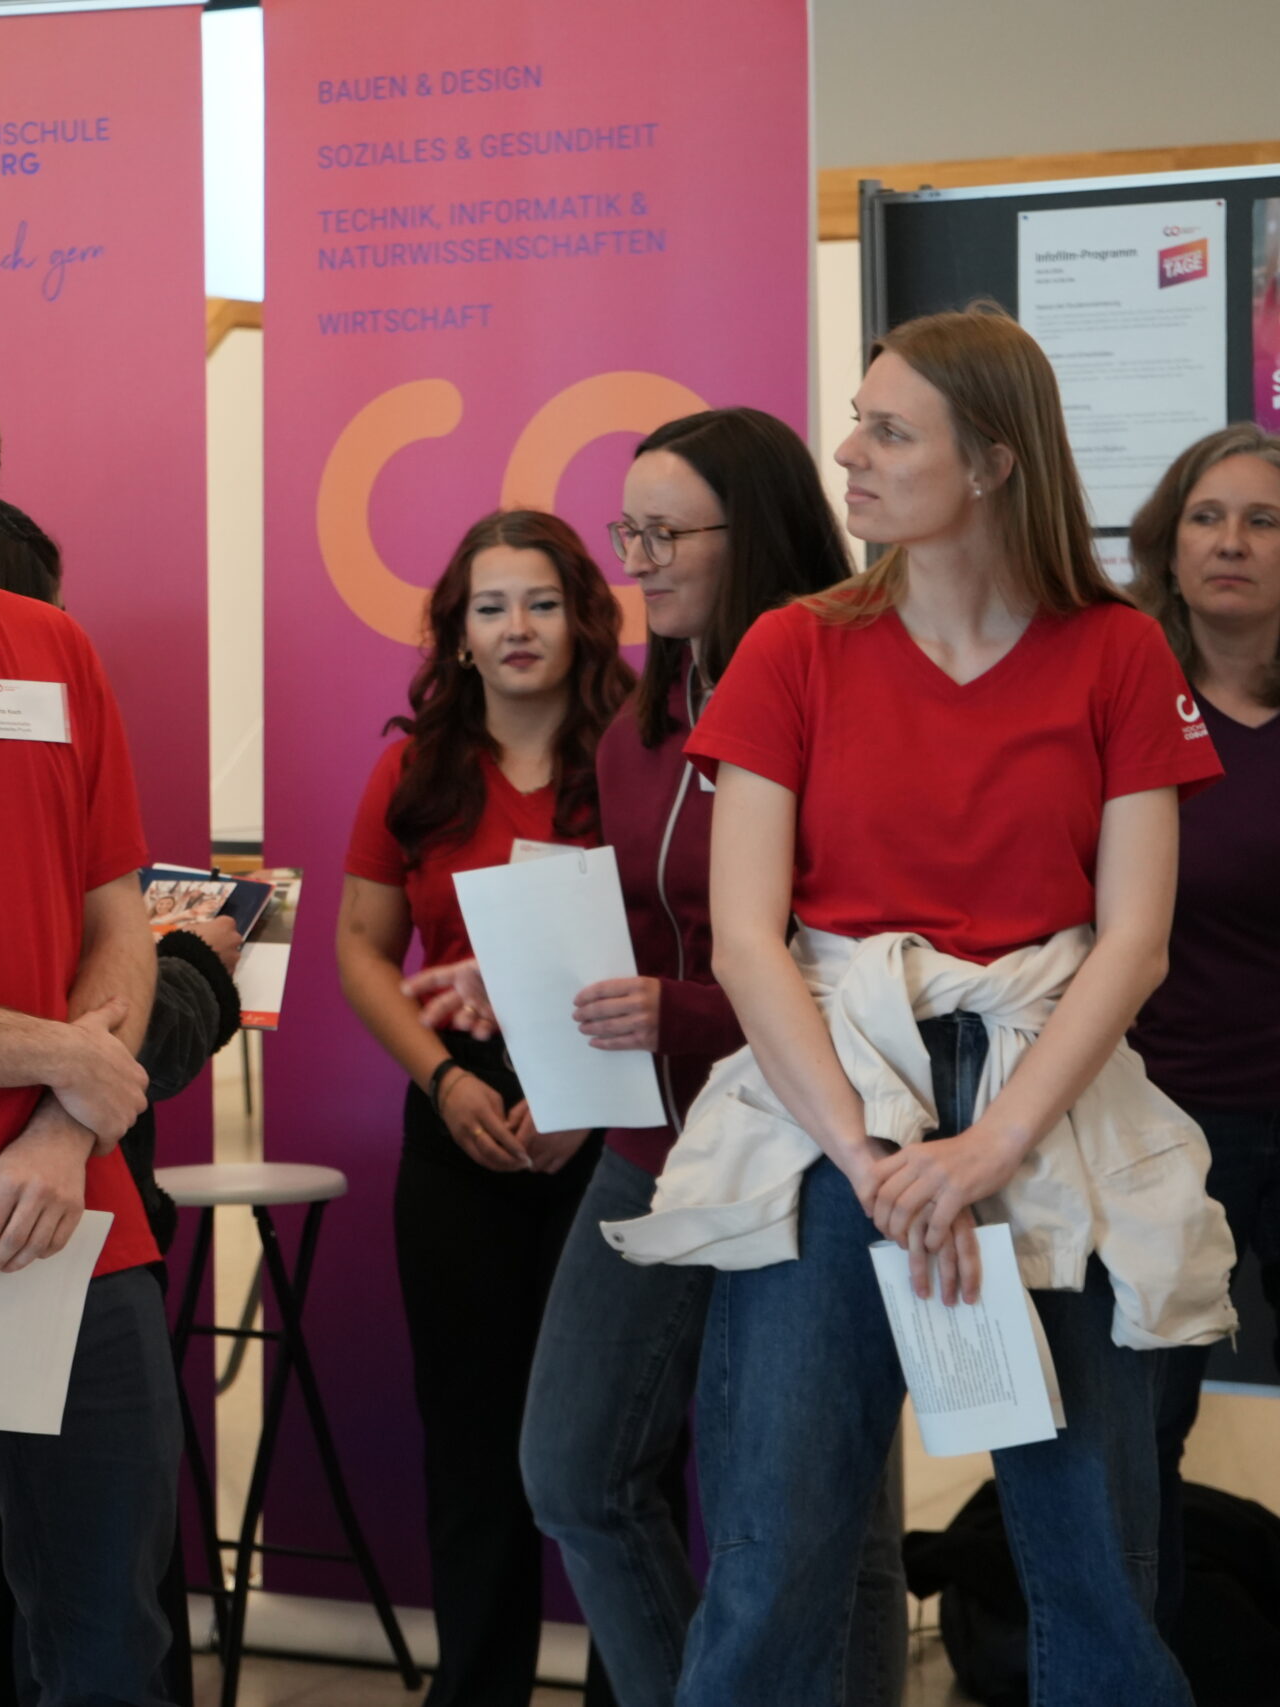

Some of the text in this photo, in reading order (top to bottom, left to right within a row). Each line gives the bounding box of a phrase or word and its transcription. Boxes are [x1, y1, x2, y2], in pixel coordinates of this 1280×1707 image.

[318, 65, 543, 105] BAUEN & DESIGN
[318, 122, 659, 169] SOZIALES & GESUNDHEIT
[319, 191, 649, 234] TECHNIK, INFORMATIK &
[318, 229, 667, 270] NATURWISSENSCHAFTEN
[1035, 248, 1138, 265] Infofilm-Programm
[1163, 255, 1204, 279] TAGE
[318, 304, 493, 335] WIRTSCHAFT
